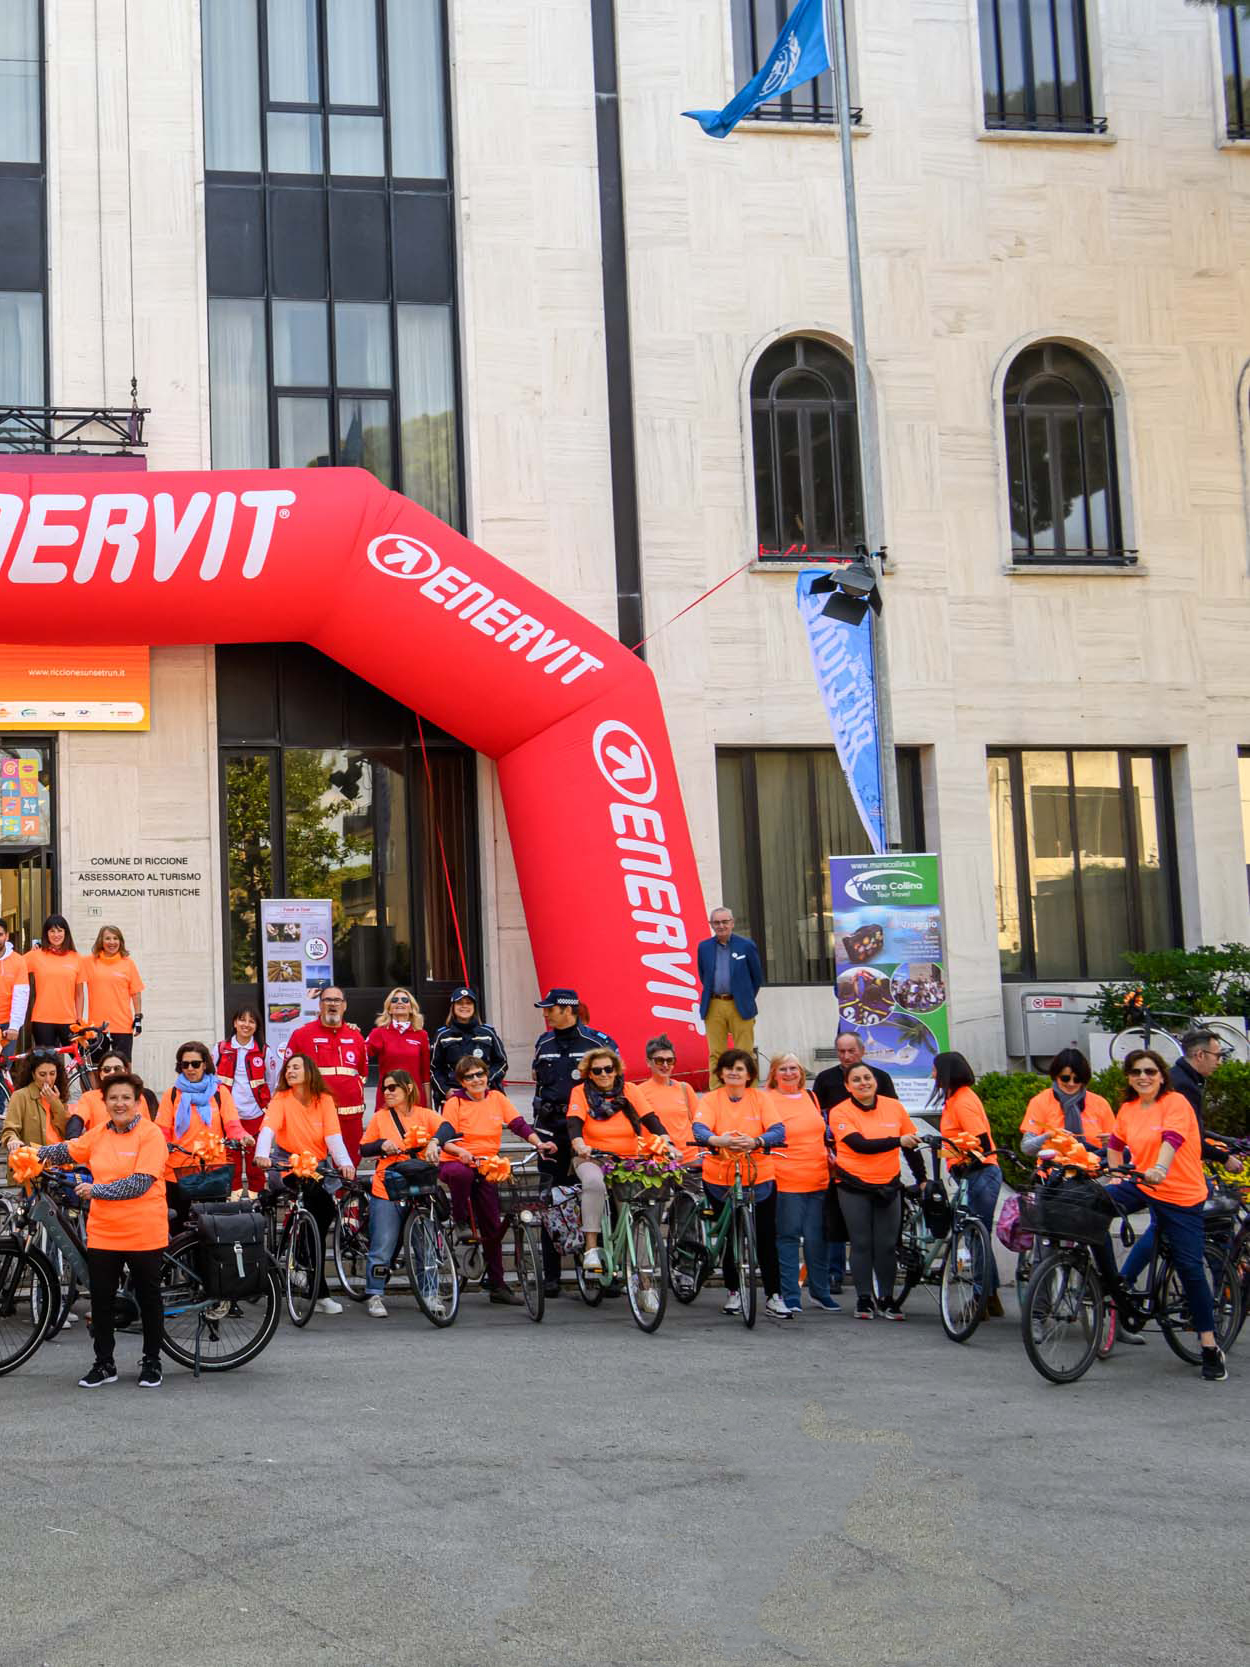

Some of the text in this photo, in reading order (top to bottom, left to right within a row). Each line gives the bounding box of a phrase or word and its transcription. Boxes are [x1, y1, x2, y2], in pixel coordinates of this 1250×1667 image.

[419, 566, 605, 685] ENERVIT
[28, 668, 126, 677] www.riccionesunsetrun.it
[90, 857, 188, 866] COMUNE DI RICCIONE
[851, 861, 917, 869] www.marecollina.it
[78, 873, 145, 881] ASSESSORATO
[160, 873, 202, 881] TURISMO
[862, 881, 923, 891] Mare Collina
[82, 888, 201, 897] NFORMAZIONI TURISTICHE
[610, 802, 707, 1036] ENERVIT
